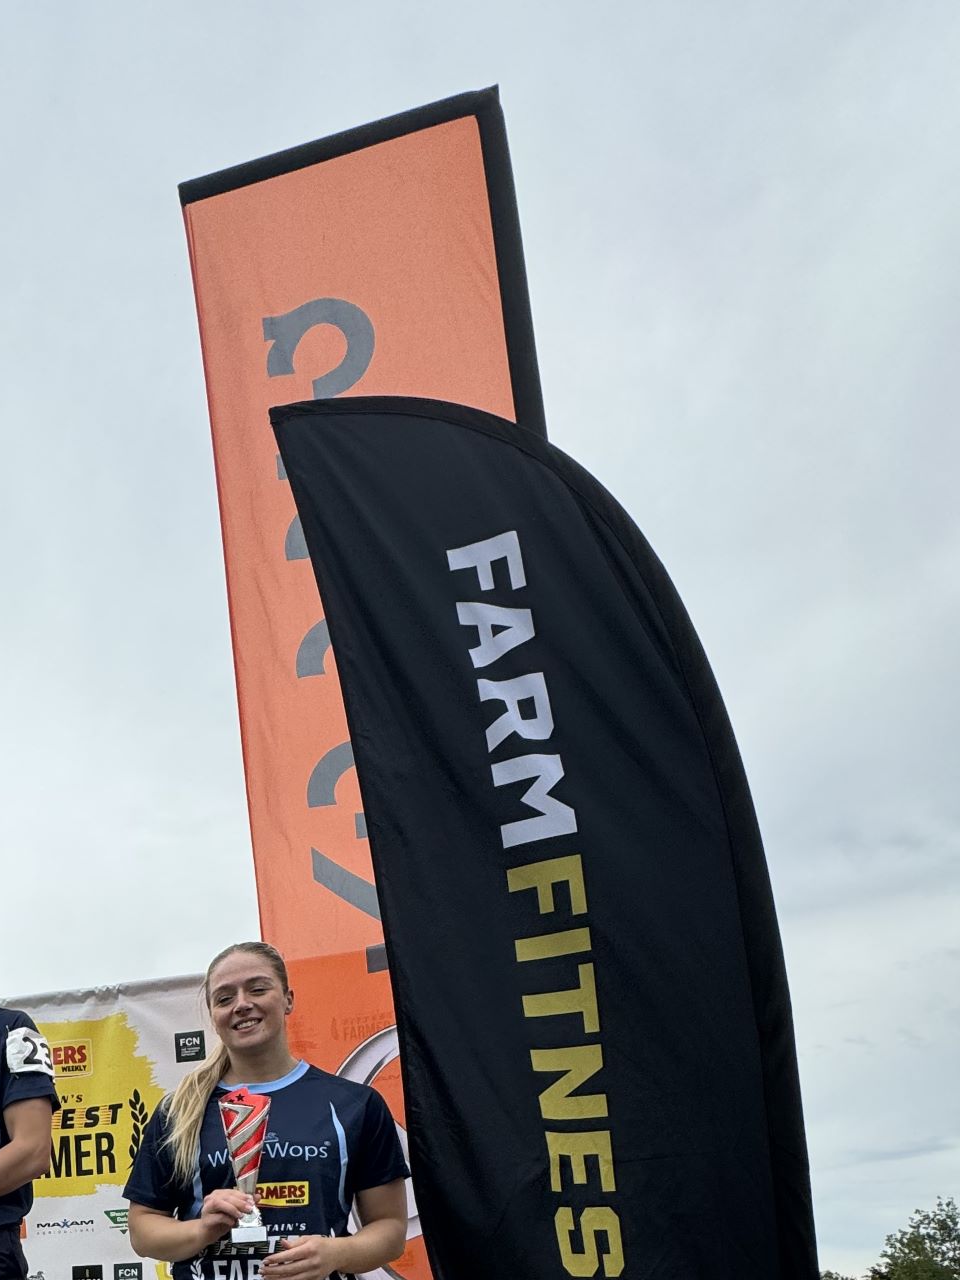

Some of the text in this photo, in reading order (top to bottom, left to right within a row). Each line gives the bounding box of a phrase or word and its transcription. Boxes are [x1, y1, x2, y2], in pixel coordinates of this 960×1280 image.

[179, 1037, 200, 1047] FCN
[34, 1132, 117, 1179] MER
[208, 1142, 328, 1168] W-Wops
[256, 1184, 306, 1199] RMERS
[36, 1219, 94, 1229] MAXAM
[266, 1223, 307, 1231] TAIN'S
[118, 1268, 138, 1277] FCN
